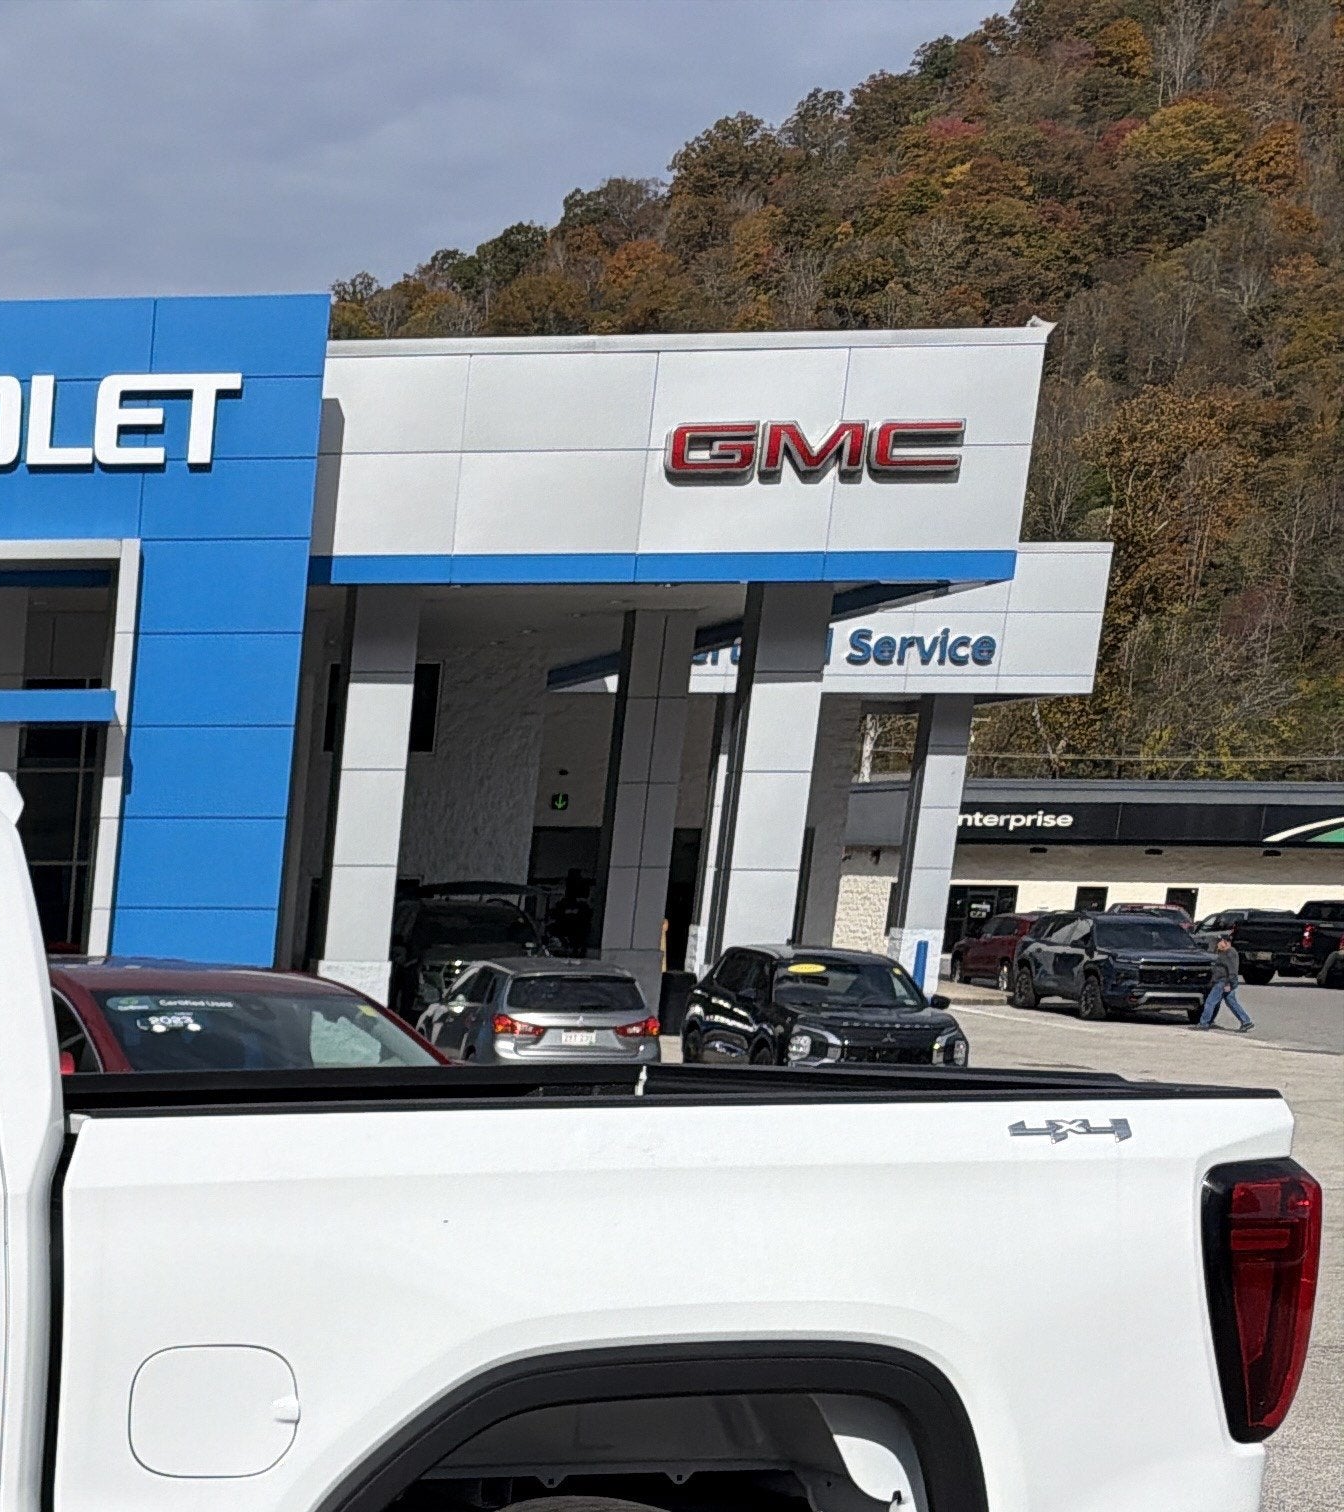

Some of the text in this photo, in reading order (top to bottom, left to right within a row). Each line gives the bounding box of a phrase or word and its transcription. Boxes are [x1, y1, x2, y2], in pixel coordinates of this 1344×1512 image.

[664, 418, 966, 484] GMC
[845, 626, 998, 667] Service
[957, 810, 1074, 832] nterprise
